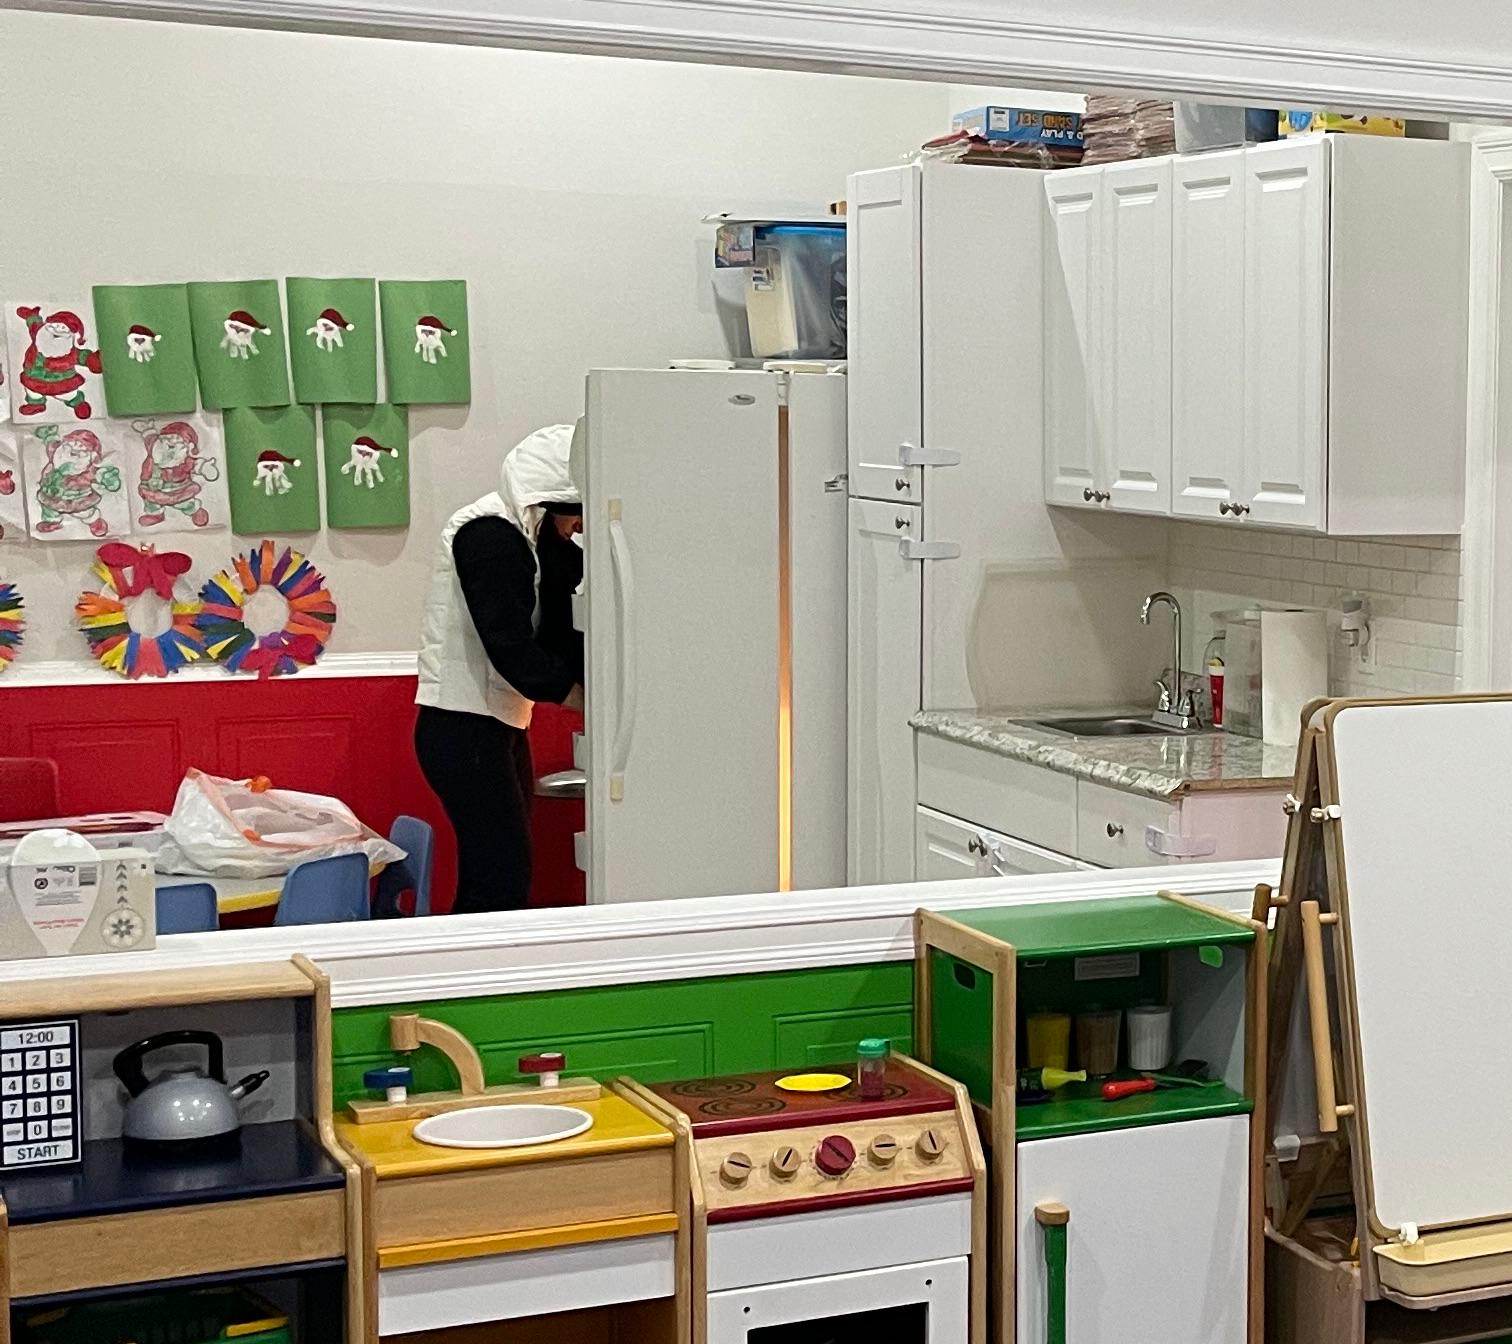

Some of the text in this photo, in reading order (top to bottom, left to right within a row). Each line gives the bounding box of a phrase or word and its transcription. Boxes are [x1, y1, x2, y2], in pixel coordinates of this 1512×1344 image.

[1040, 128, 1064, 138] PLAY
[19, 1031, 54, 1044] 12:00
[10, 1053, 64, 1068] 1 2 3
[8, 1076, 65, 1091] 4 5 6
[9, 1099, 65, 1115] 7 8 9
[33, 1124, 42, 1135] 0
[17, 1145, 59, 1160] START
